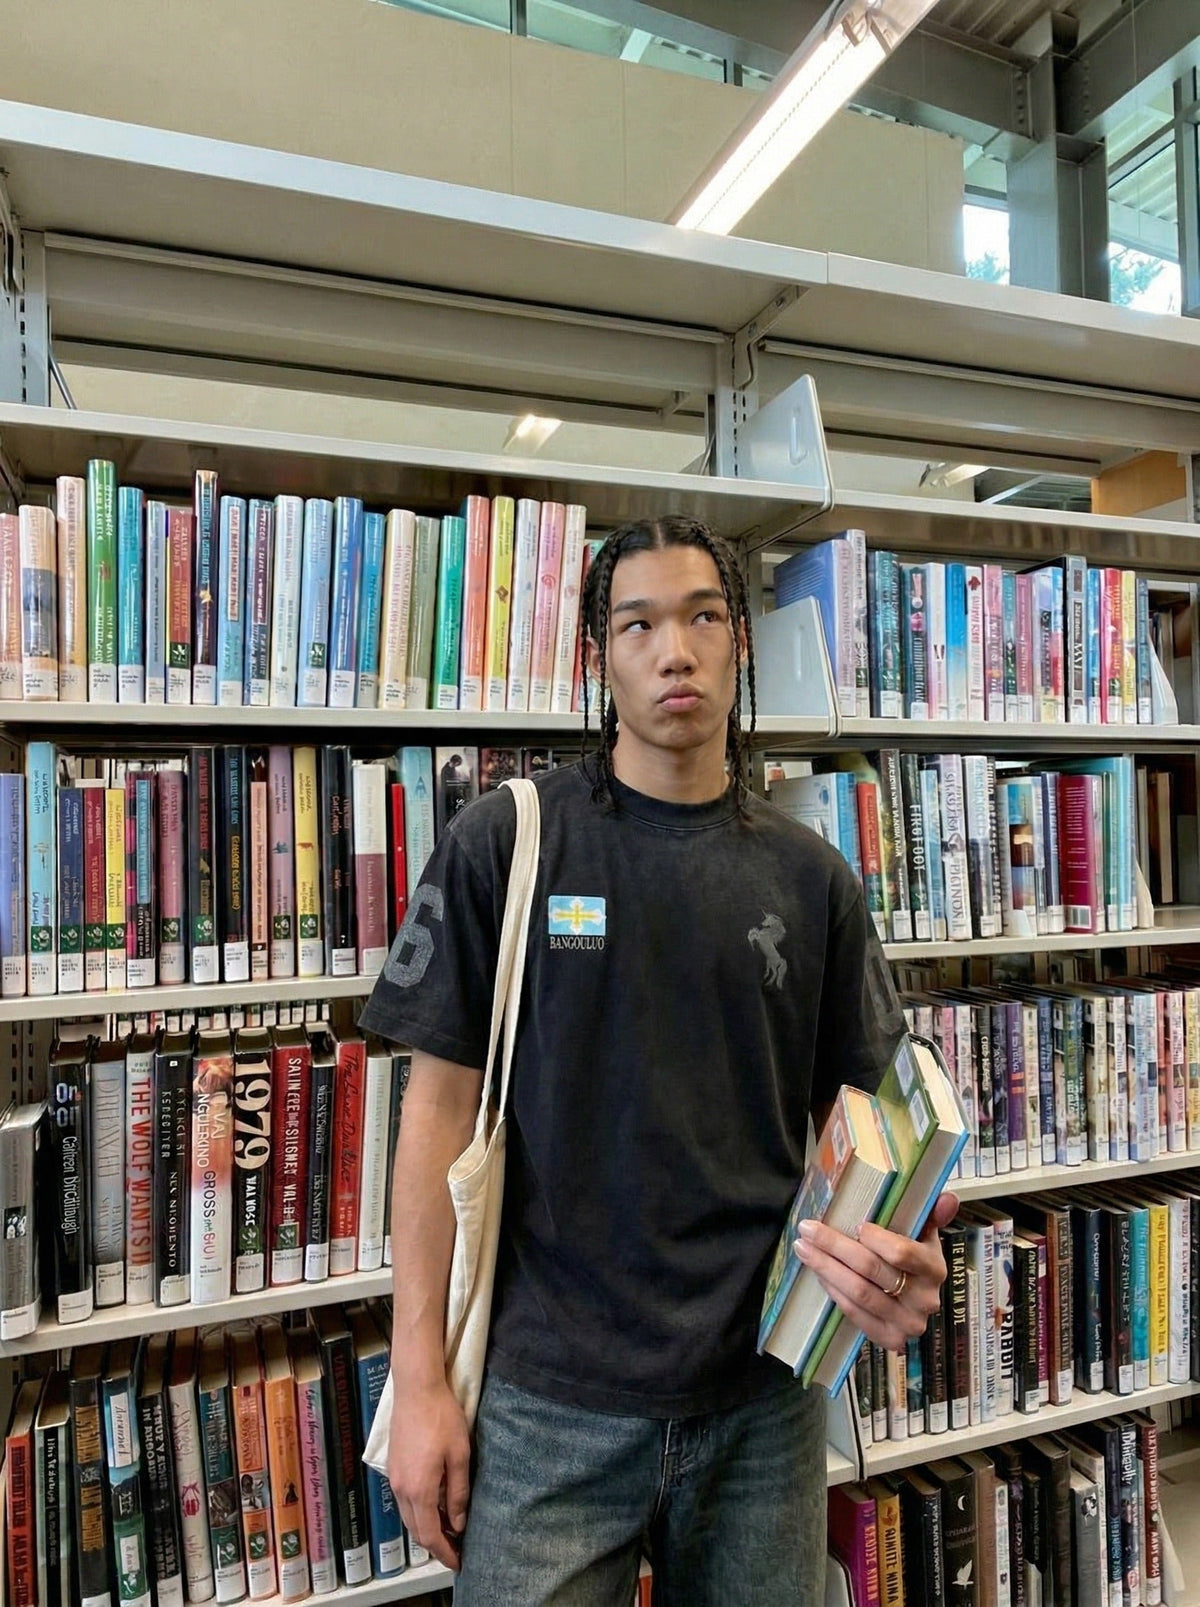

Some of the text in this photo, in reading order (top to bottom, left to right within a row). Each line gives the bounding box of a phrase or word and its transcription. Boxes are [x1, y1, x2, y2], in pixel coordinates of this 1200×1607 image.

[384, 883, 444, 988] 6
[131, 1077, 151, 1117] THE
[234, 1059, 271, 1170] 1979
[131, 1120, 152, 1172] WOLF
[203, 1171, 217, 1218] GROSS
